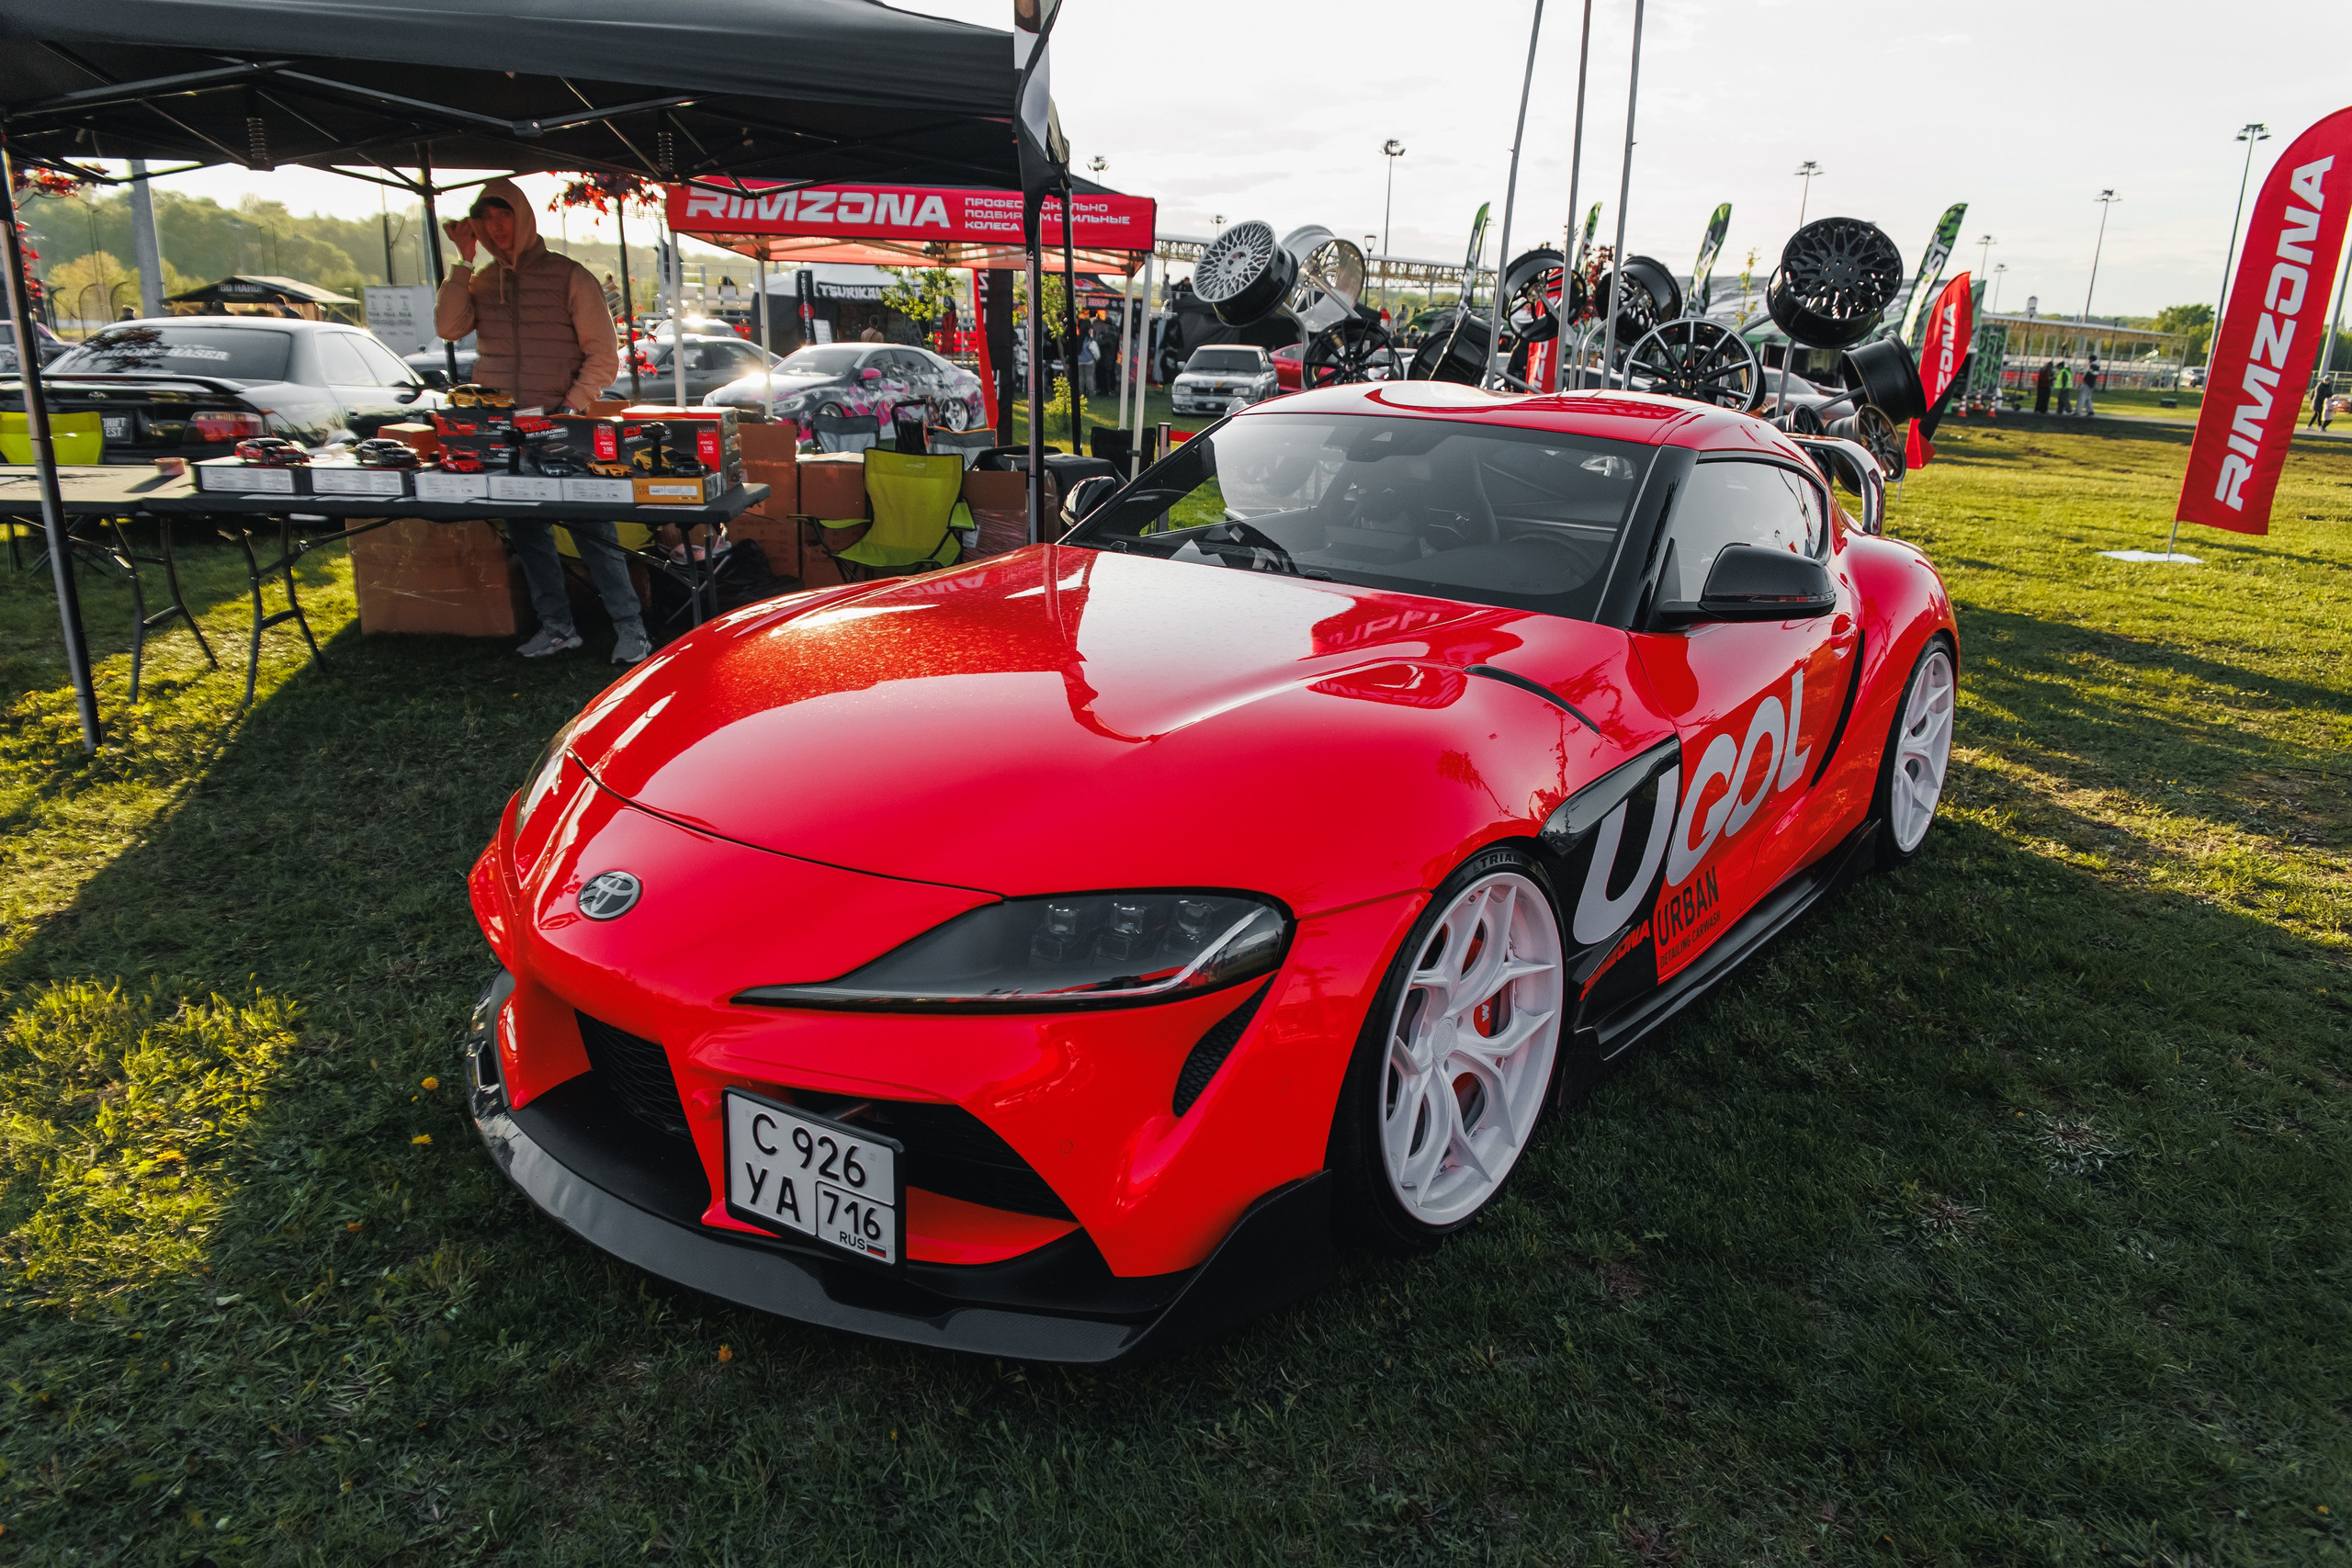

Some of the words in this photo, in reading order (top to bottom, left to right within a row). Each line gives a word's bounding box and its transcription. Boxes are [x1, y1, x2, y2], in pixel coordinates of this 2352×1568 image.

[686, 186, 950, 228] RIMZONA
[965, 221, 1020, 231] КОЛЕСА
[1054, 214, 1130, 225] СИЛЬНЫЕ
[2214, 154, 2335, 512] RIMZONA
[104, 427, 121, 437] EST
[518, 420, 551, 434] CAR
[1572, 668, 1812, 945] UGOL
[1657, 866, 1719, 946] URBAN
[1660, 933, 1691, 969] DETAILING
[1691, 909, 1721, 942] CARWASH
[792, 1127, 866, 1188] 926
[823, 1190, 881, 1240] 716
[839, 1231, 865, 1250] RUS
